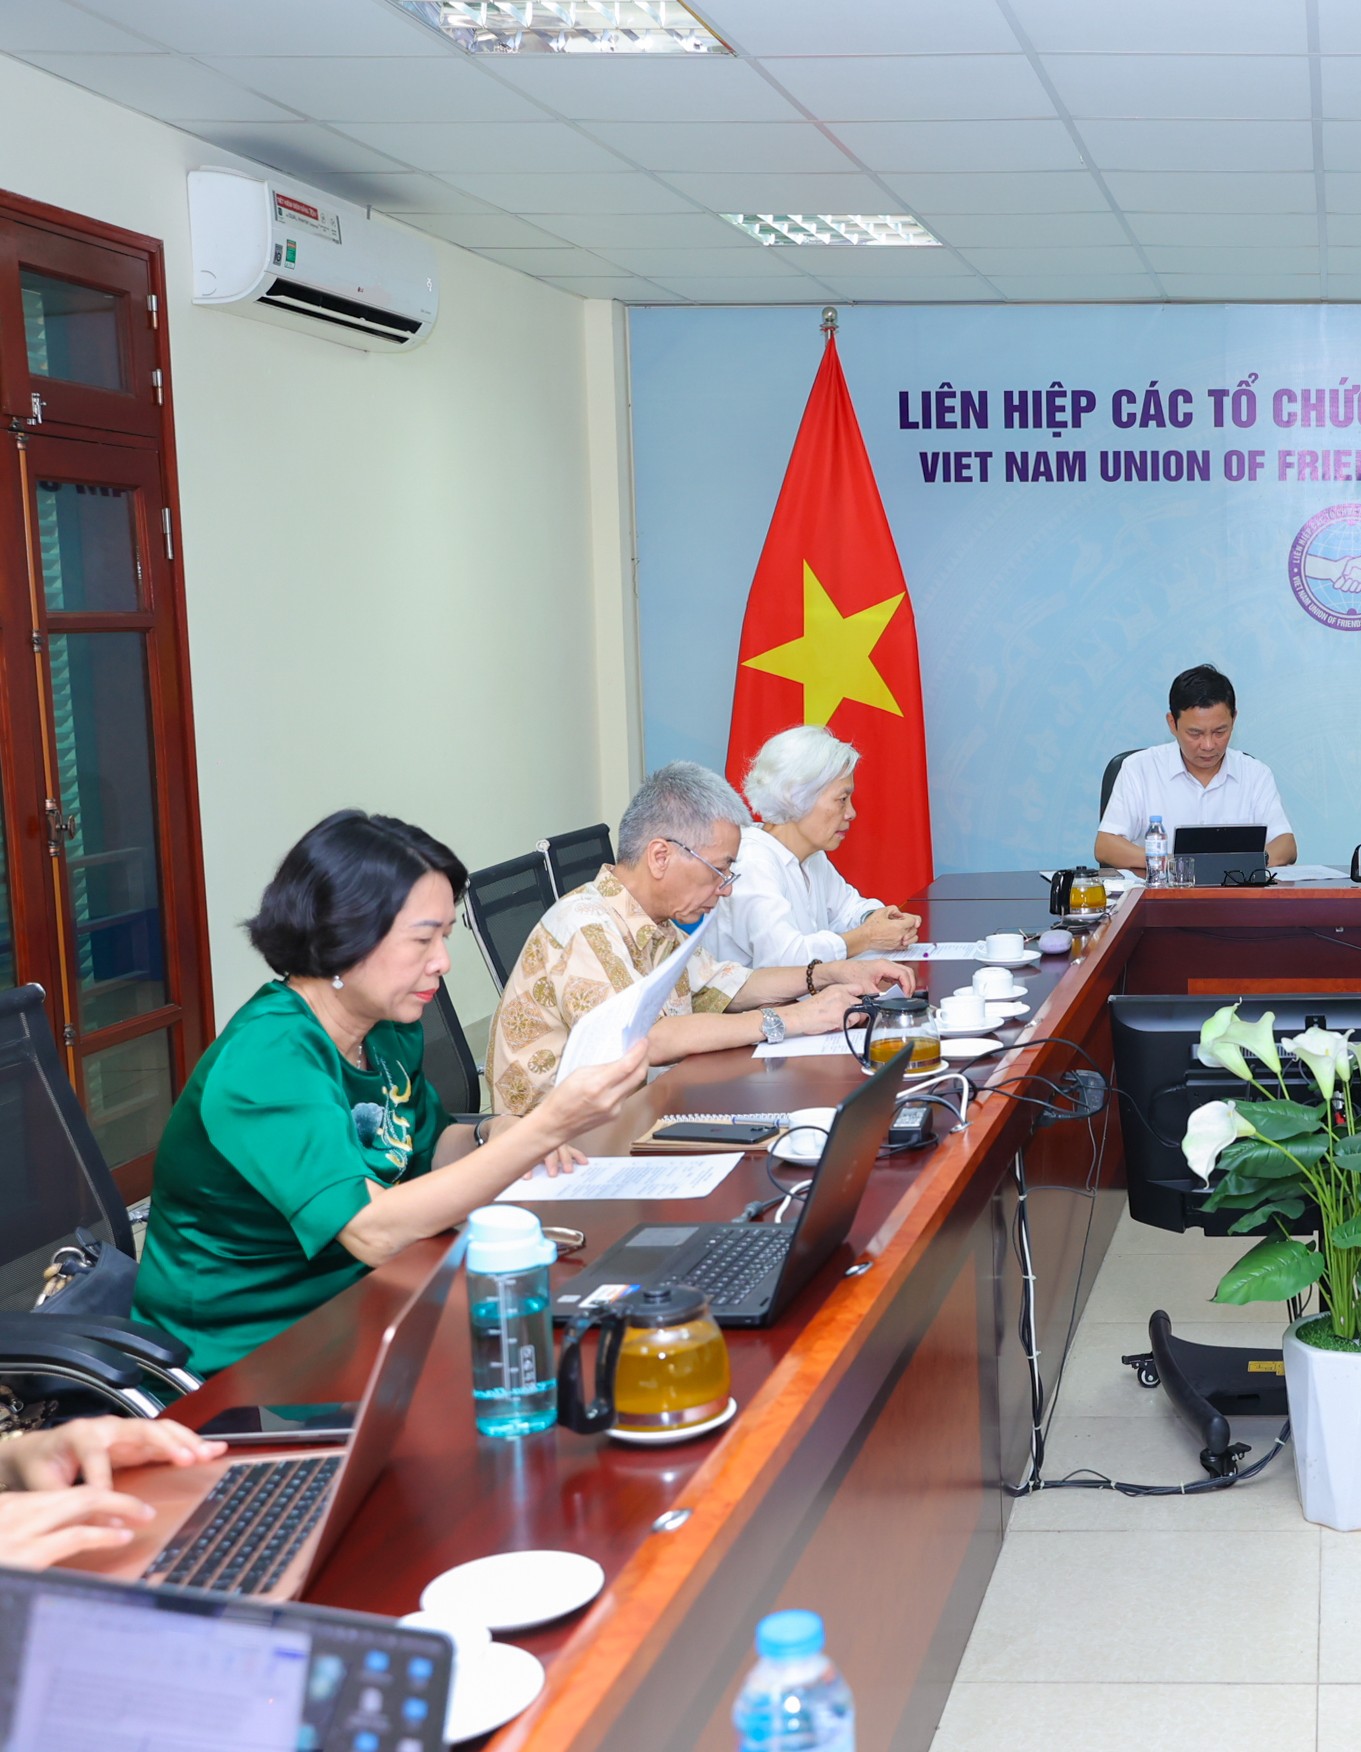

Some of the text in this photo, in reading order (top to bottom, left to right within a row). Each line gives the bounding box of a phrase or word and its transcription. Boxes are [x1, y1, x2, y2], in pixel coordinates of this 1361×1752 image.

[899, 381, 988, 430] LIÊN
[1003, 380, 1096, 438] HIỆP
[1112, 380, 1193, 429] CÁC
[1208, 372, 1259, 428] TỔ
[919, 451, 993, 483] VIET
[1005, 451, 1087, 483] NAM
[1100, 450, 1211, 482] UNION
[1224, 449, 1265, 481] OF
[1293, 576, 1303, 591] VIET
[1298, 590, 1311, 606] NAM
[1308, 603, 1328, 621] UNION
[1327, 615, 1337, 625] OF
